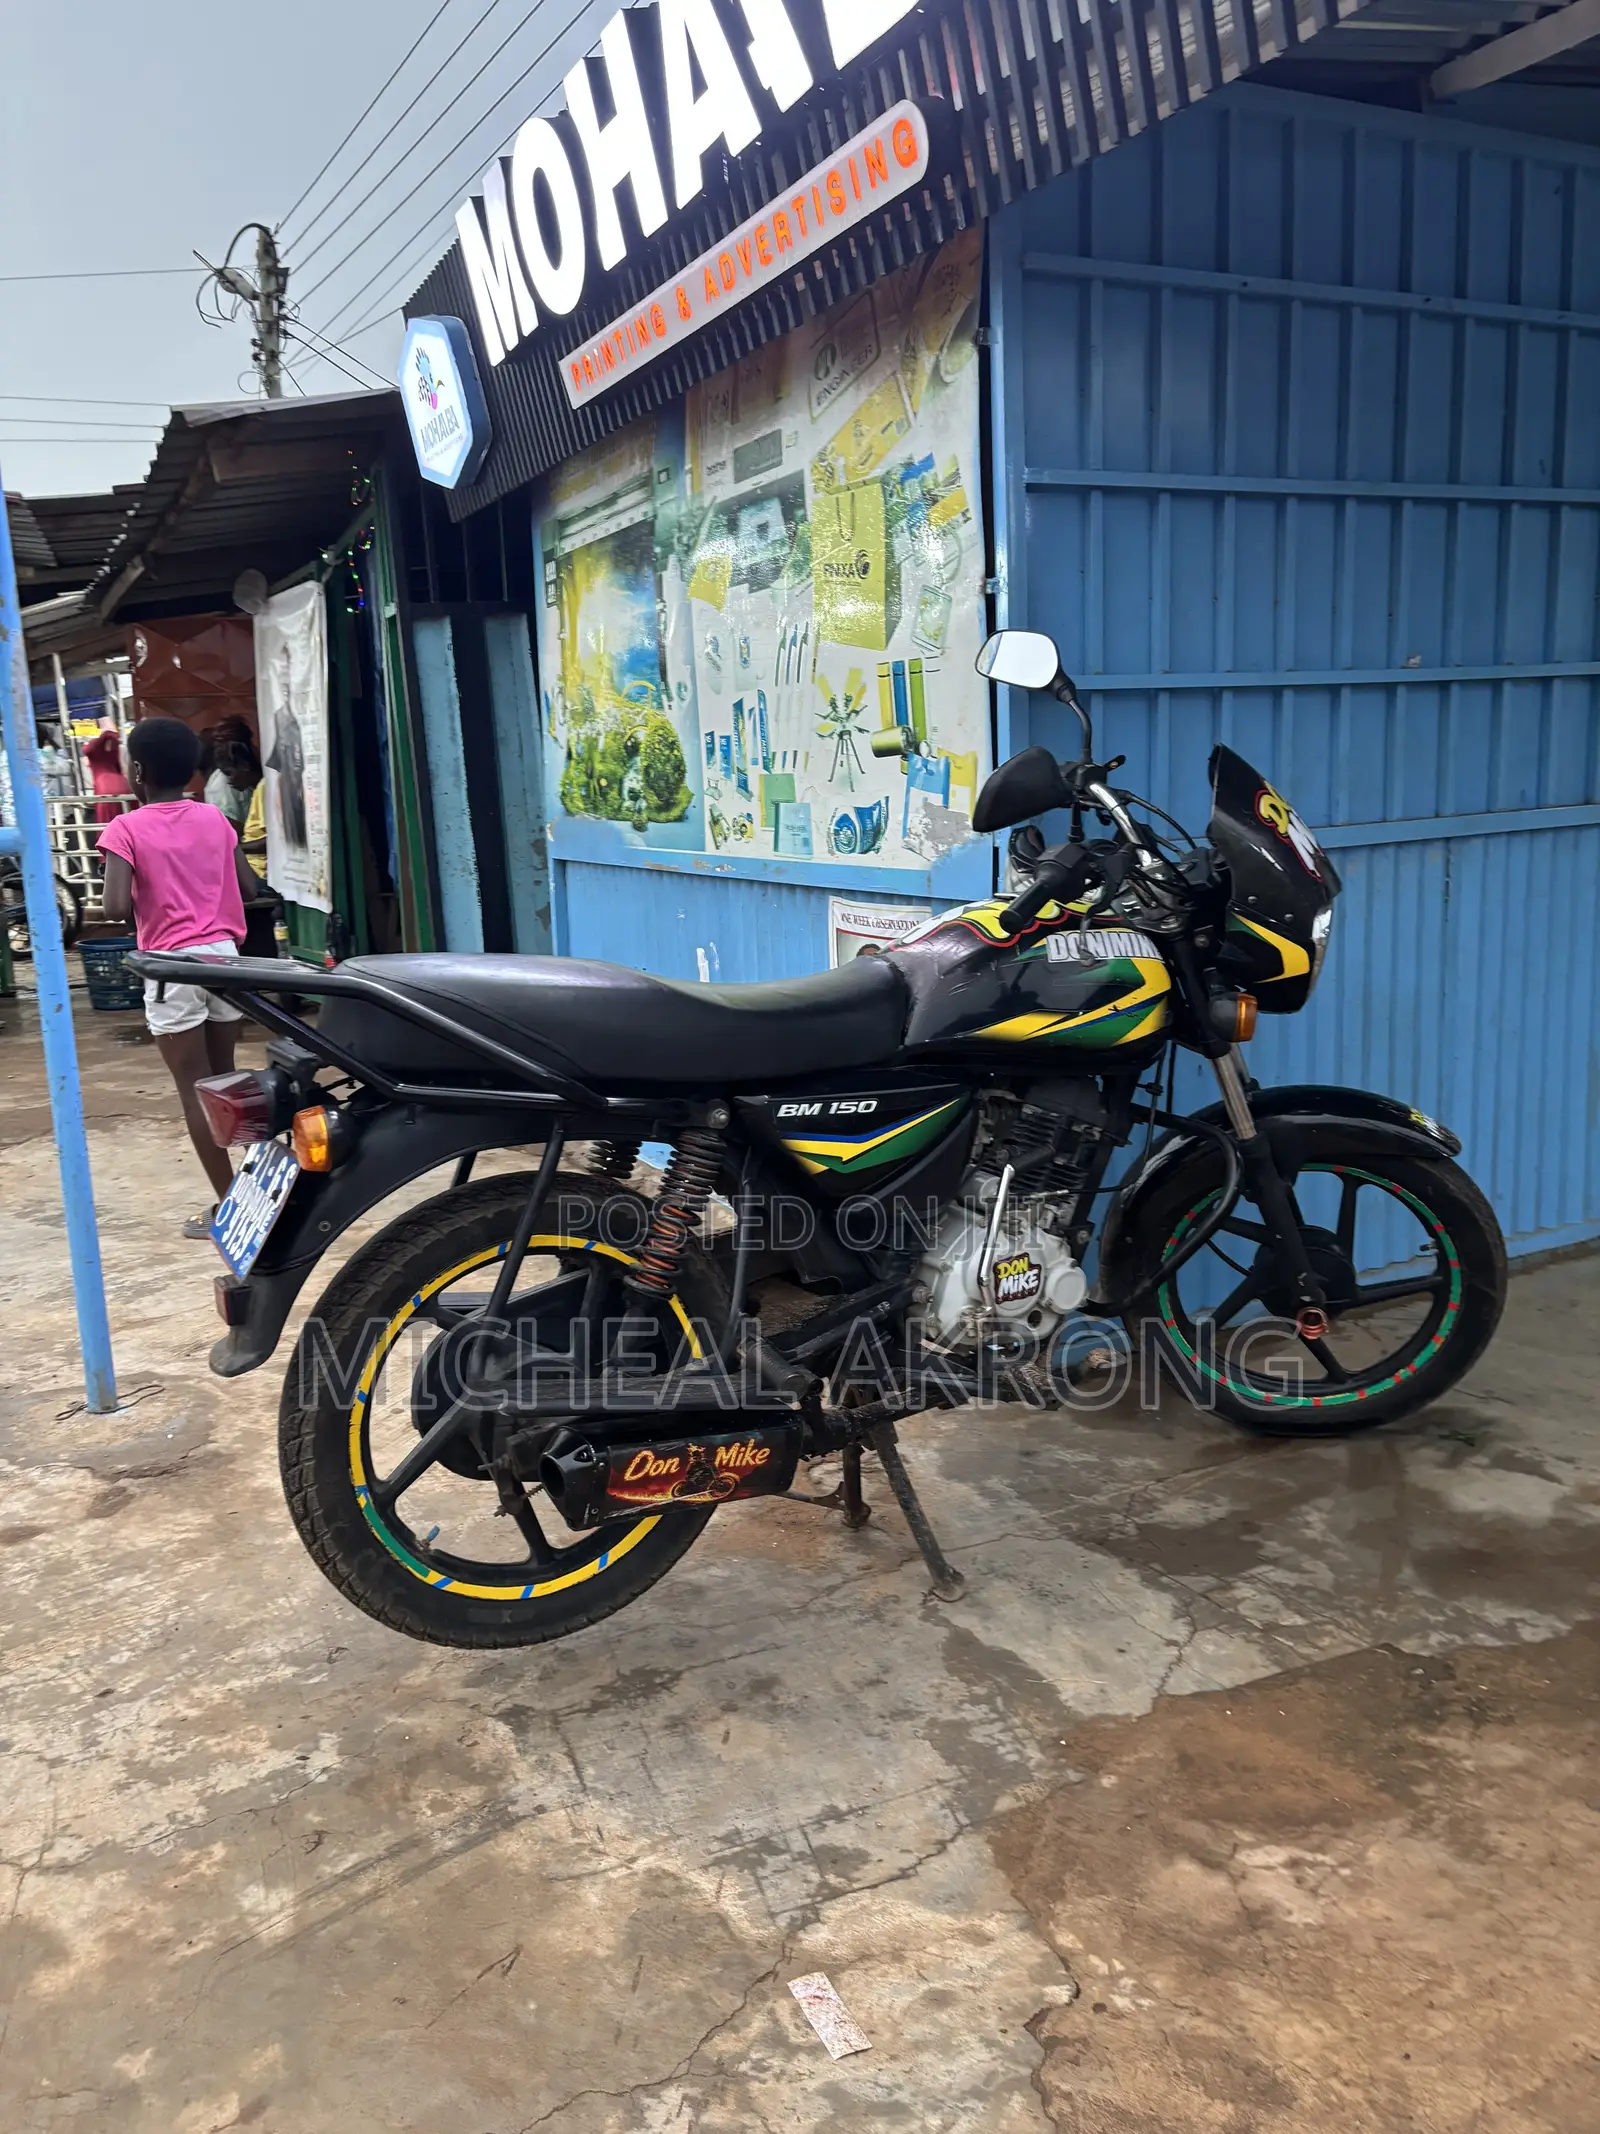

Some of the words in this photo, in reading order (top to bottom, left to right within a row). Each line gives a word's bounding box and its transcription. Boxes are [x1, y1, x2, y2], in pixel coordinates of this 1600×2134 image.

[455, 0, 920, 366] MOHA
[570, 303, 668, 393] PRINTING
[675, 286, 693, 322] &
[703, 118, 919, 304] ADVERTISING
[777, 1102, 823, 1118] BM
[828, 1100, 878, 1115] 150
[997, 1256, 1029, 1279] DON
[624, 1450, 681, 1482] Don
[714, 1438, 771, 1468] Mike
